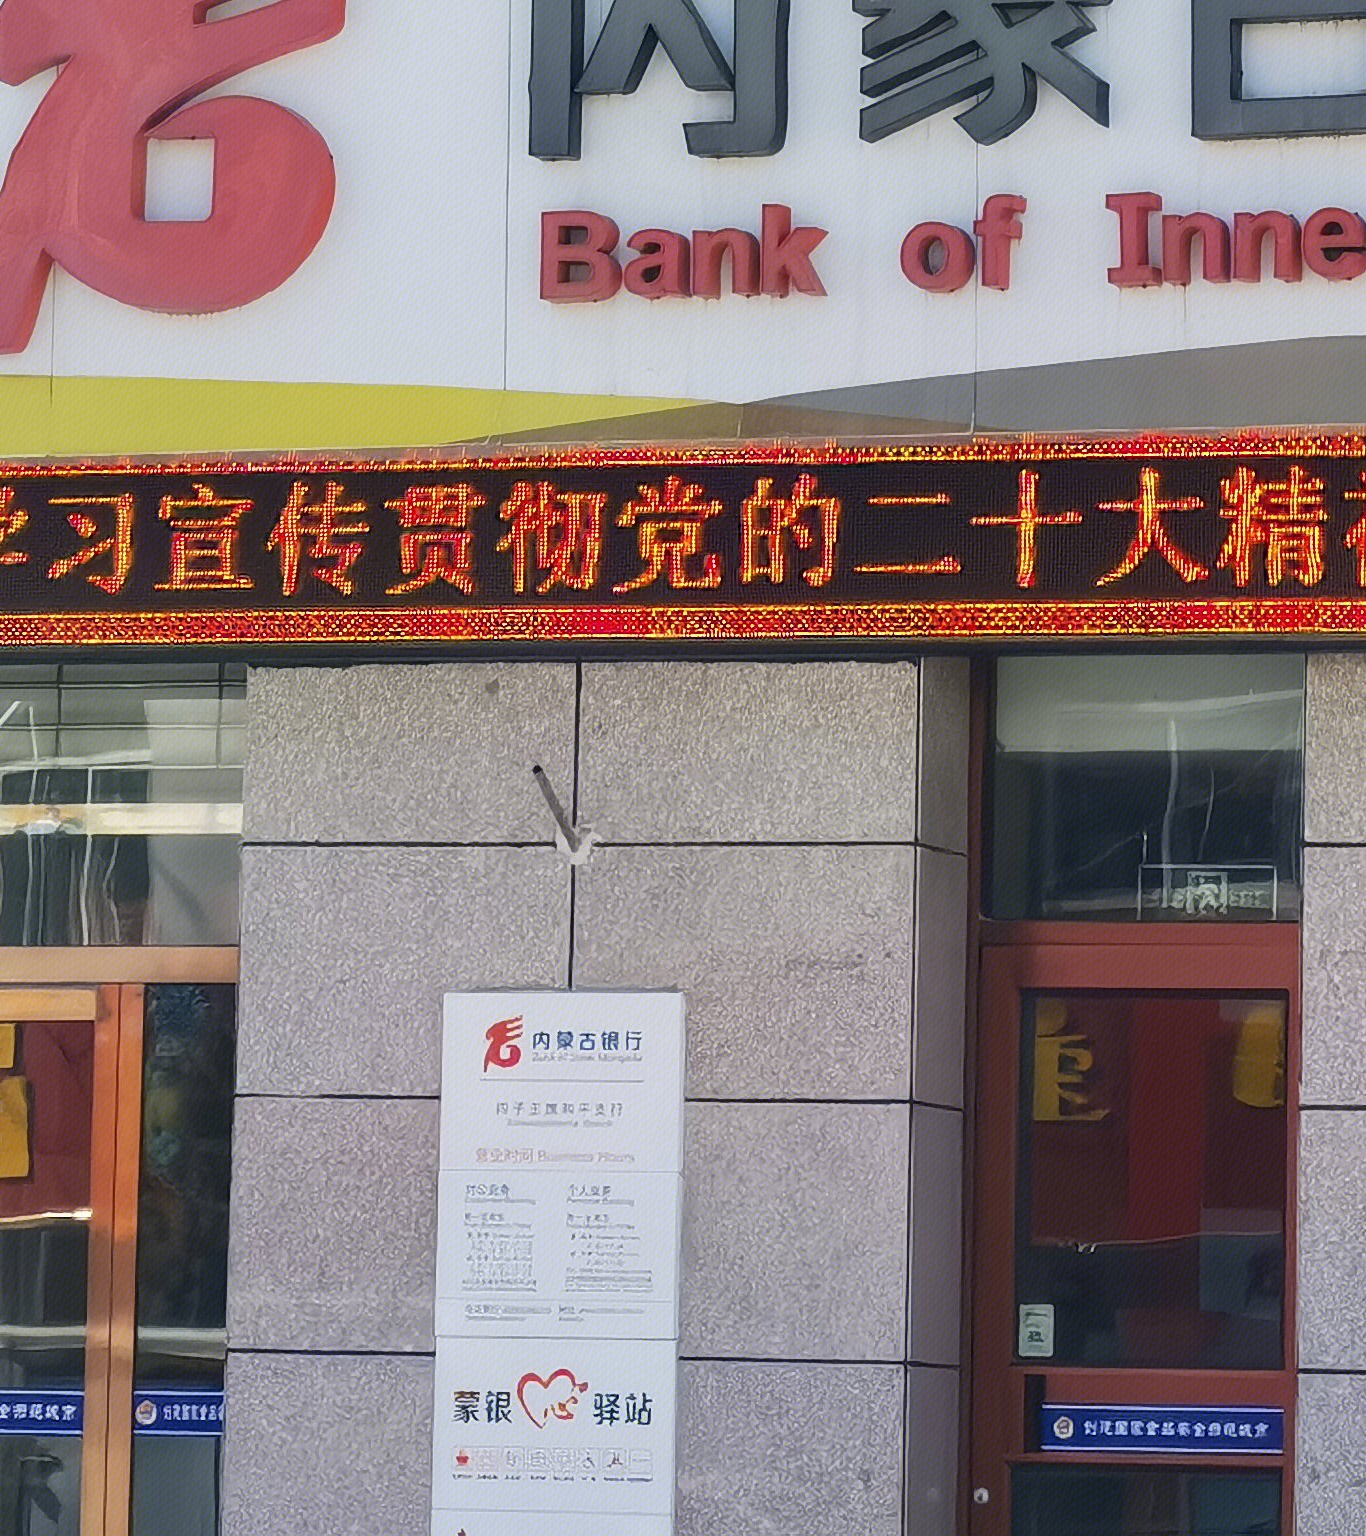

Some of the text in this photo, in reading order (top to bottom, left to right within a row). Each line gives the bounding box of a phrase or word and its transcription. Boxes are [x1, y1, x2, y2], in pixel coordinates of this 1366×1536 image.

[540, 204, 827, 305] Bank
[900, 194, 1028, 294] of
[531, 1030, 643, 1051] 内蒙古银行
[451, 1390, 513, 1424] 蒙银
[592, 1392, 654, 1426] 驿站
